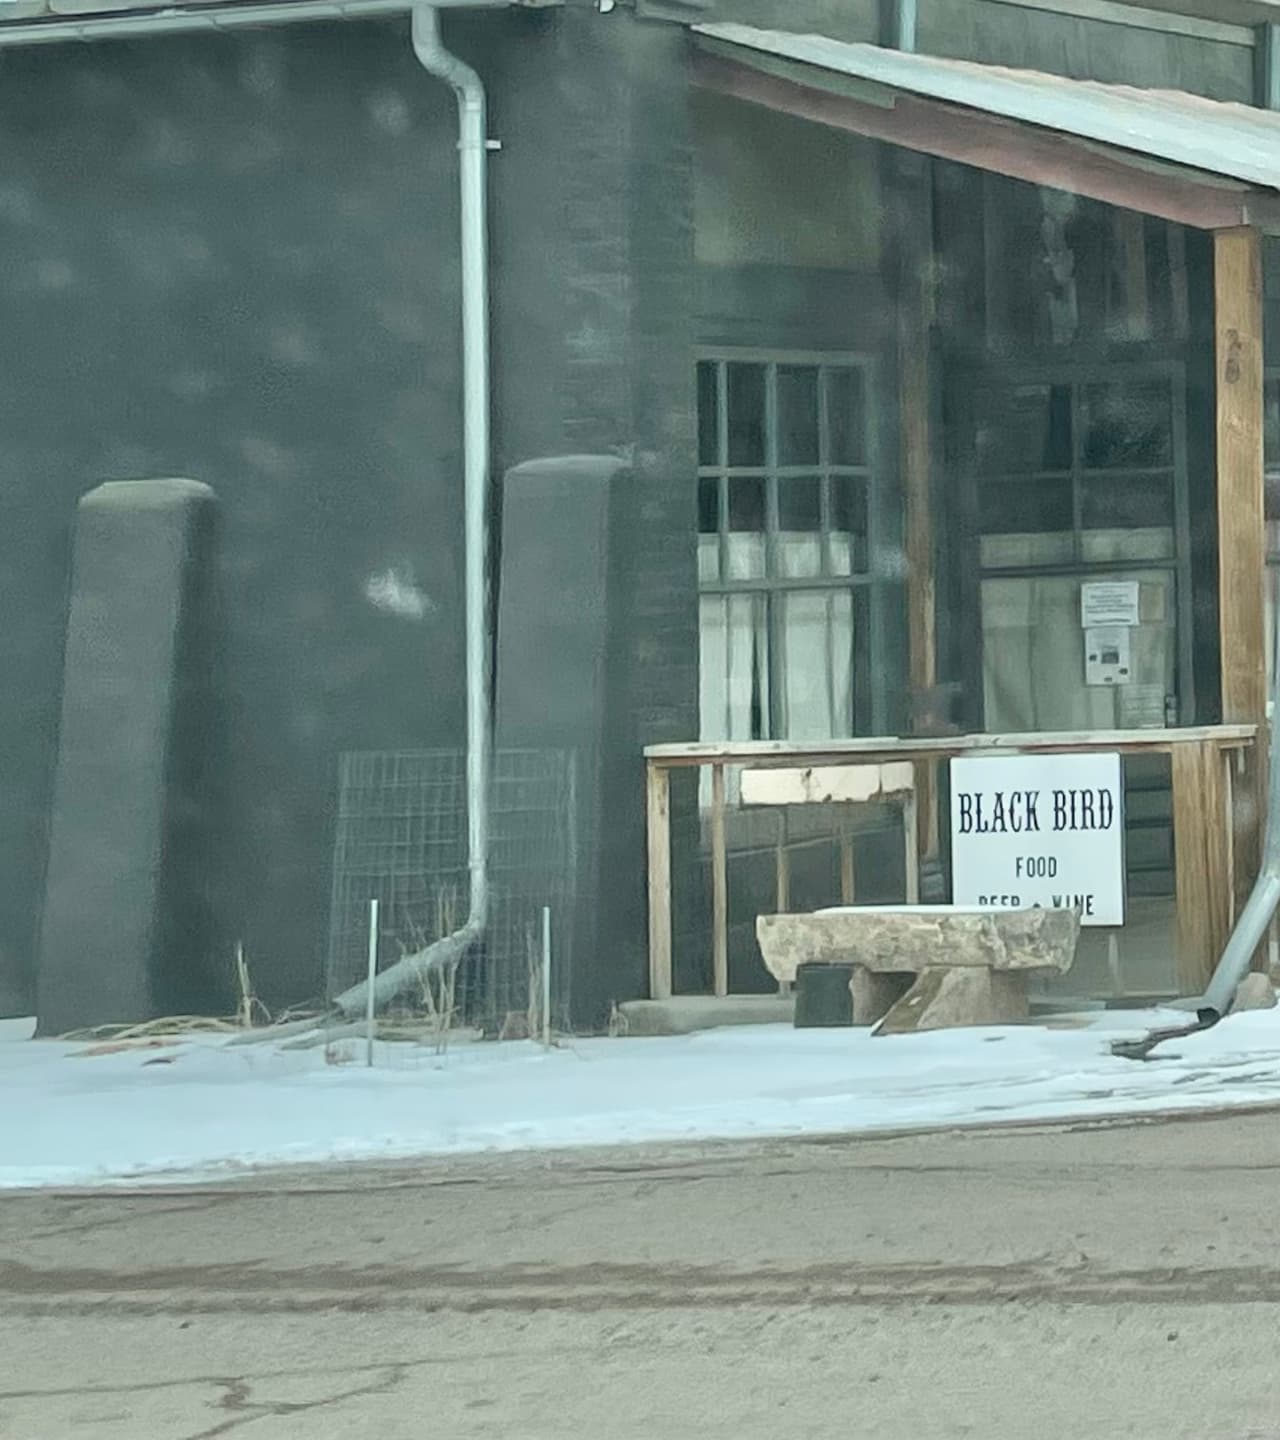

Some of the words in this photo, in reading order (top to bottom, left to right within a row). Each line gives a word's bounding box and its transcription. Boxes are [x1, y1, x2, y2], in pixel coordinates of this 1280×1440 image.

[958, 791, 1040, 833] BLACK
[1052, 789, 1114, 831] BIRD
[1016, 856, 1057, 878] FOOD
